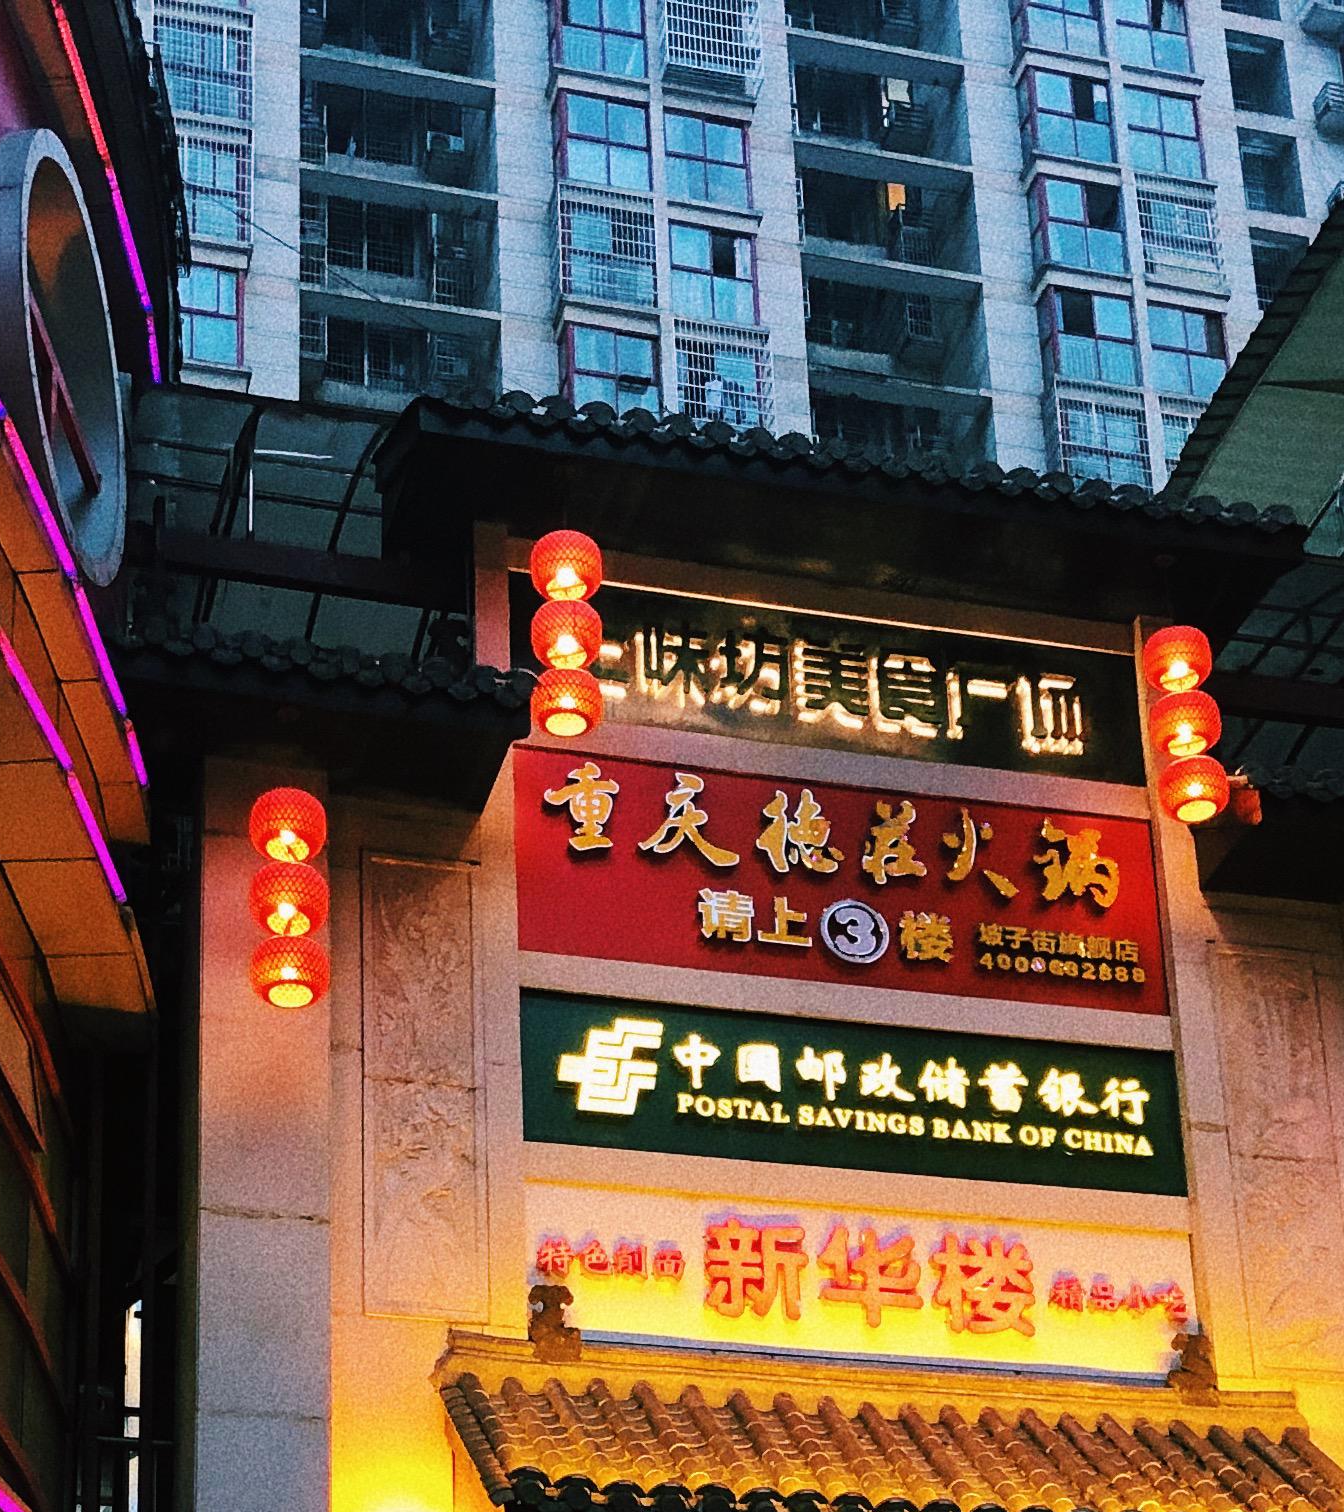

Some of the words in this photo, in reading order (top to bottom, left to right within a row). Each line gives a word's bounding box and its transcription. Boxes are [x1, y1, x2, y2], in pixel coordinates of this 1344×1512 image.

[979, 923, 1139, 962] 坡子街旗舰店
[672, 1033, 1151, 1125] 中国邮政储蓄银行
[677, 1092, 790, 1124] POSTAL
[798, 1104, 924, 1137] SAVINGS
[932, 1119, 1012, 1145] BANK
[1020, 1124, 1056, 1148] OF
[1063, 1128, 1153, 1157] CHINA
[704, 1216, 1036, 1337] 新华楼
